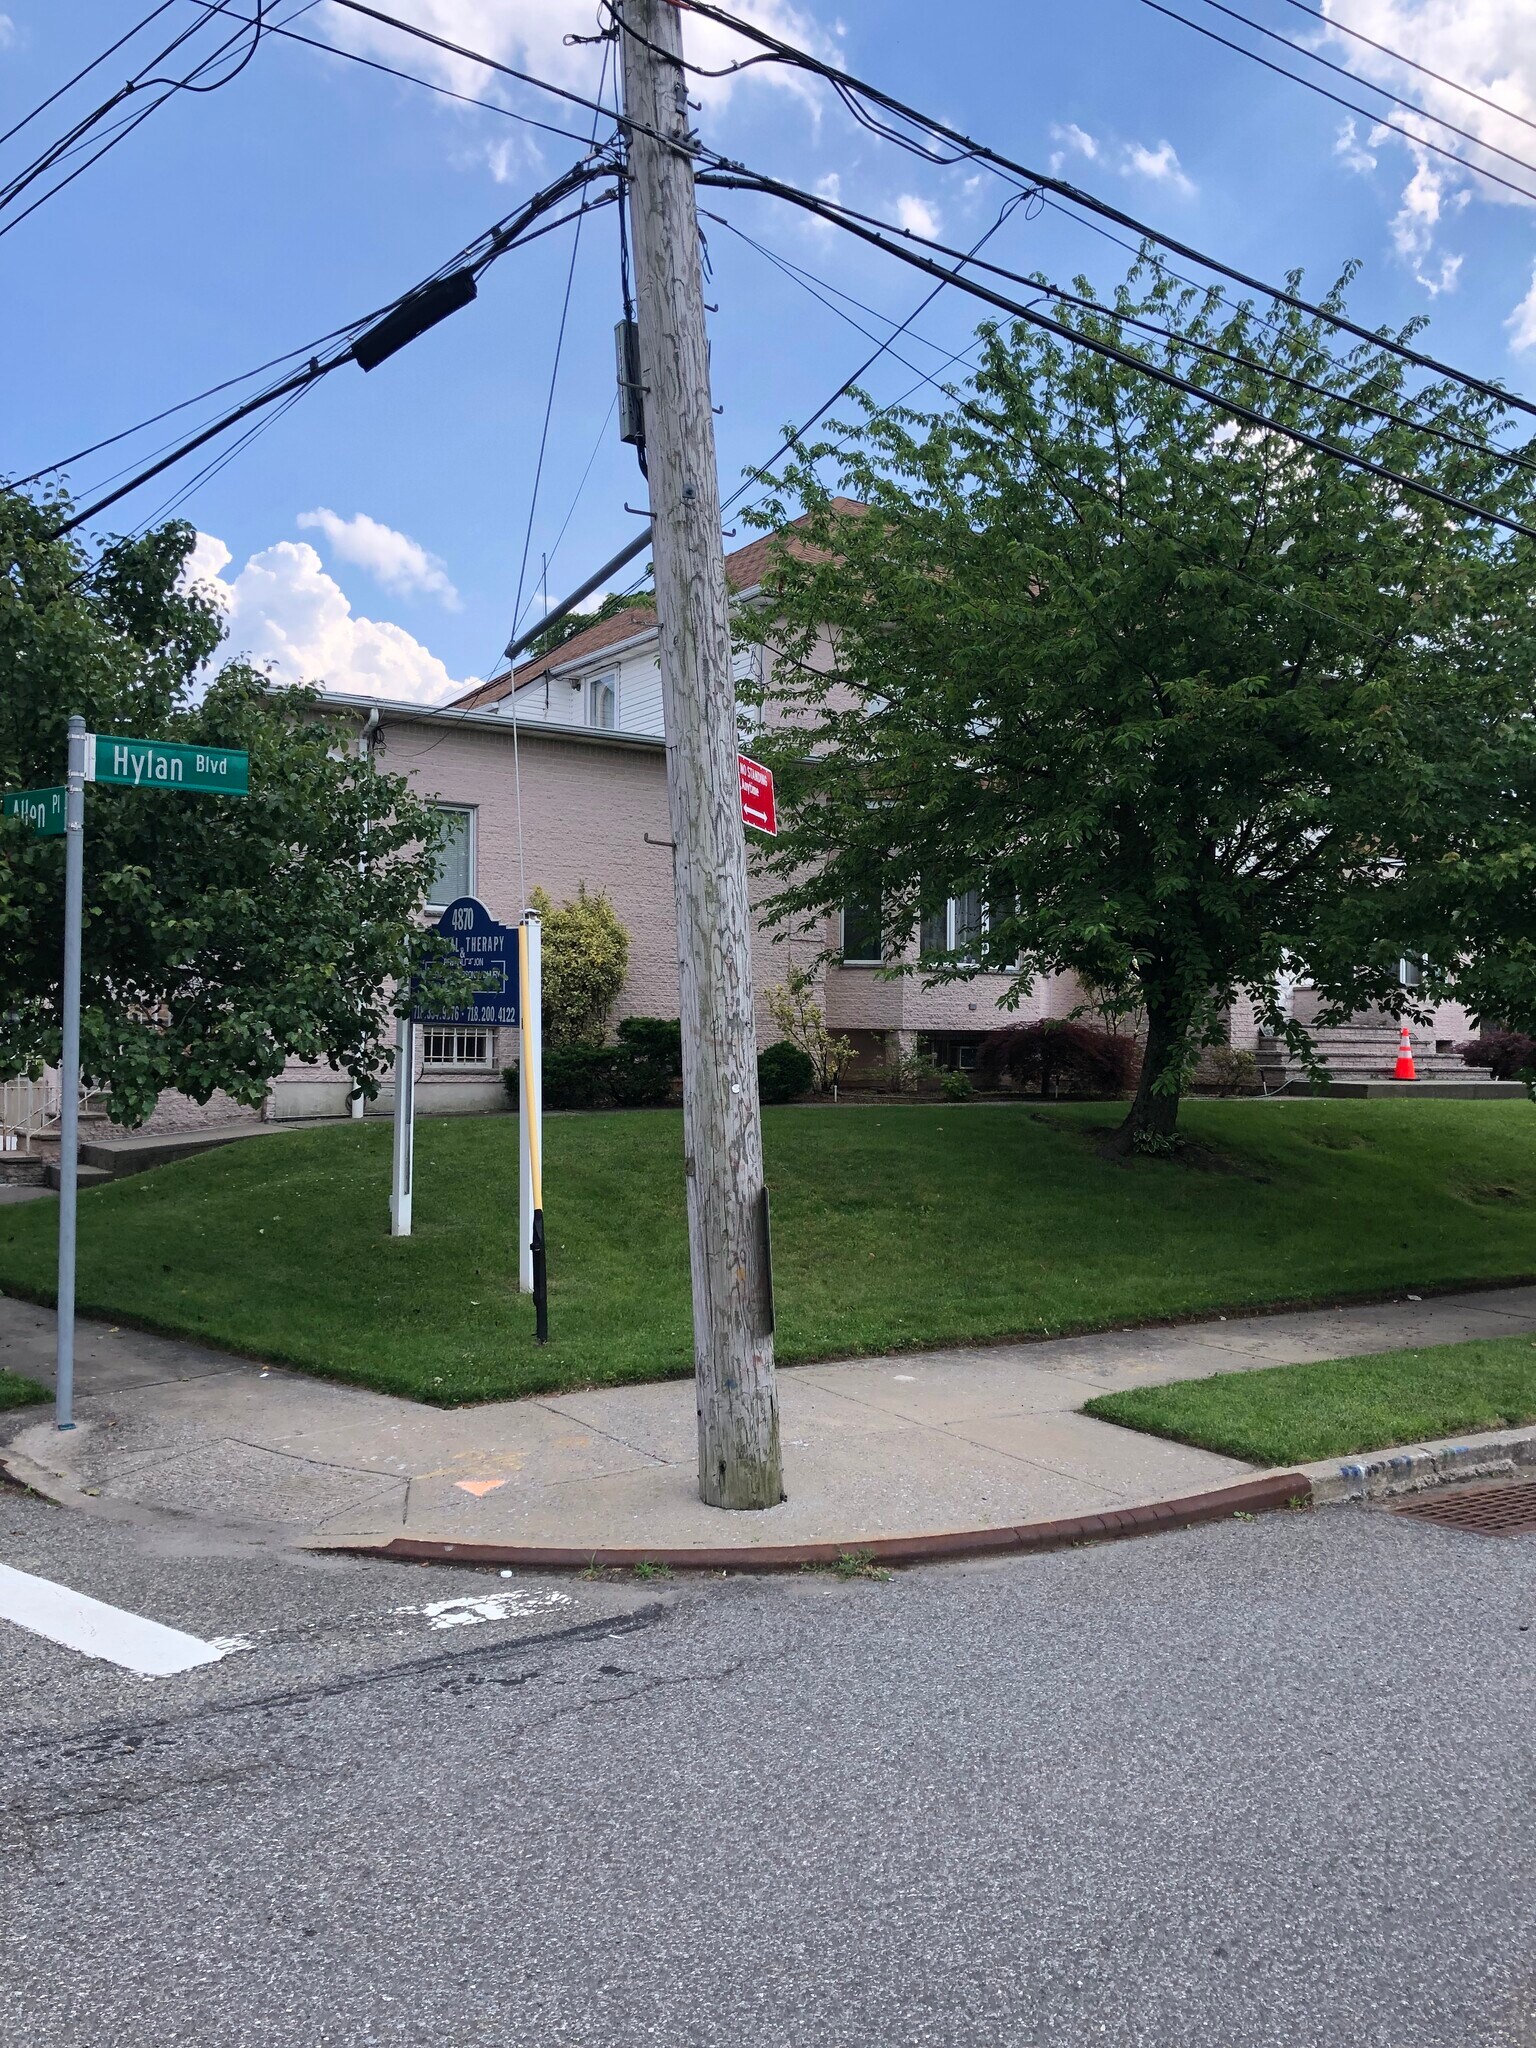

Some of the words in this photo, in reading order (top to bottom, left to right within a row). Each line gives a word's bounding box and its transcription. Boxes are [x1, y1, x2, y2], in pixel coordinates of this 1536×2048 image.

[113, 745, 183, 785] Hylan
[196, 754, 227, 775] Blvd
[739, 762, 746, 776] NO
[747, 765, 768, 787] STANDING
[741, 778, 760, 797] Anytime
[52, 793, 60, 814] Pl
[452, 907, 474, 931] 4870
[459, 947, 465, 958] &
[466, 936, 505, 952] THERAPY
[467, 1006, 515, 1022] 718.200.4122
